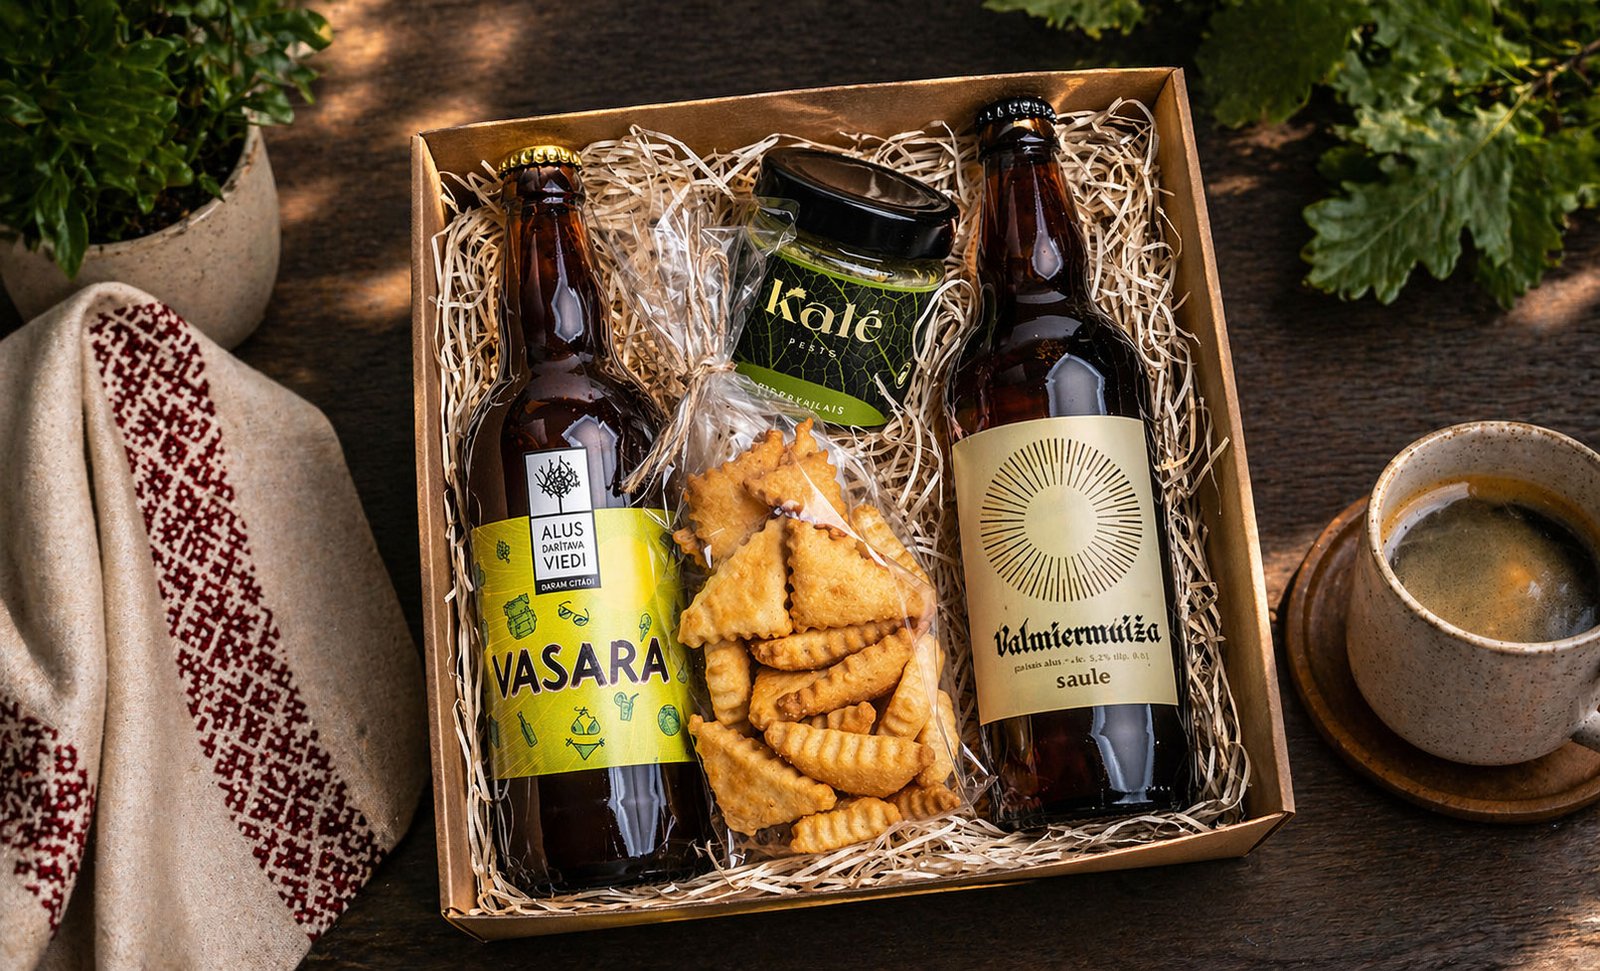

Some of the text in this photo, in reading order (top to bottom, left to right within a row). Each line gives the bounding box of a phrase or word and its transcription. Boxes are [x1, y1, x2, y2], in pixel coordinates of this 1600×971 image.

[788, 337, 837, 358] PESTS
[541, 521, 584, 541] ALUS
[543, 552, 586, 570] VIEDI
[541, 581, 568, 591] DARAM
[491, 637, 671, 699] VASARA
[1056, 668, 1111, 689] saule
